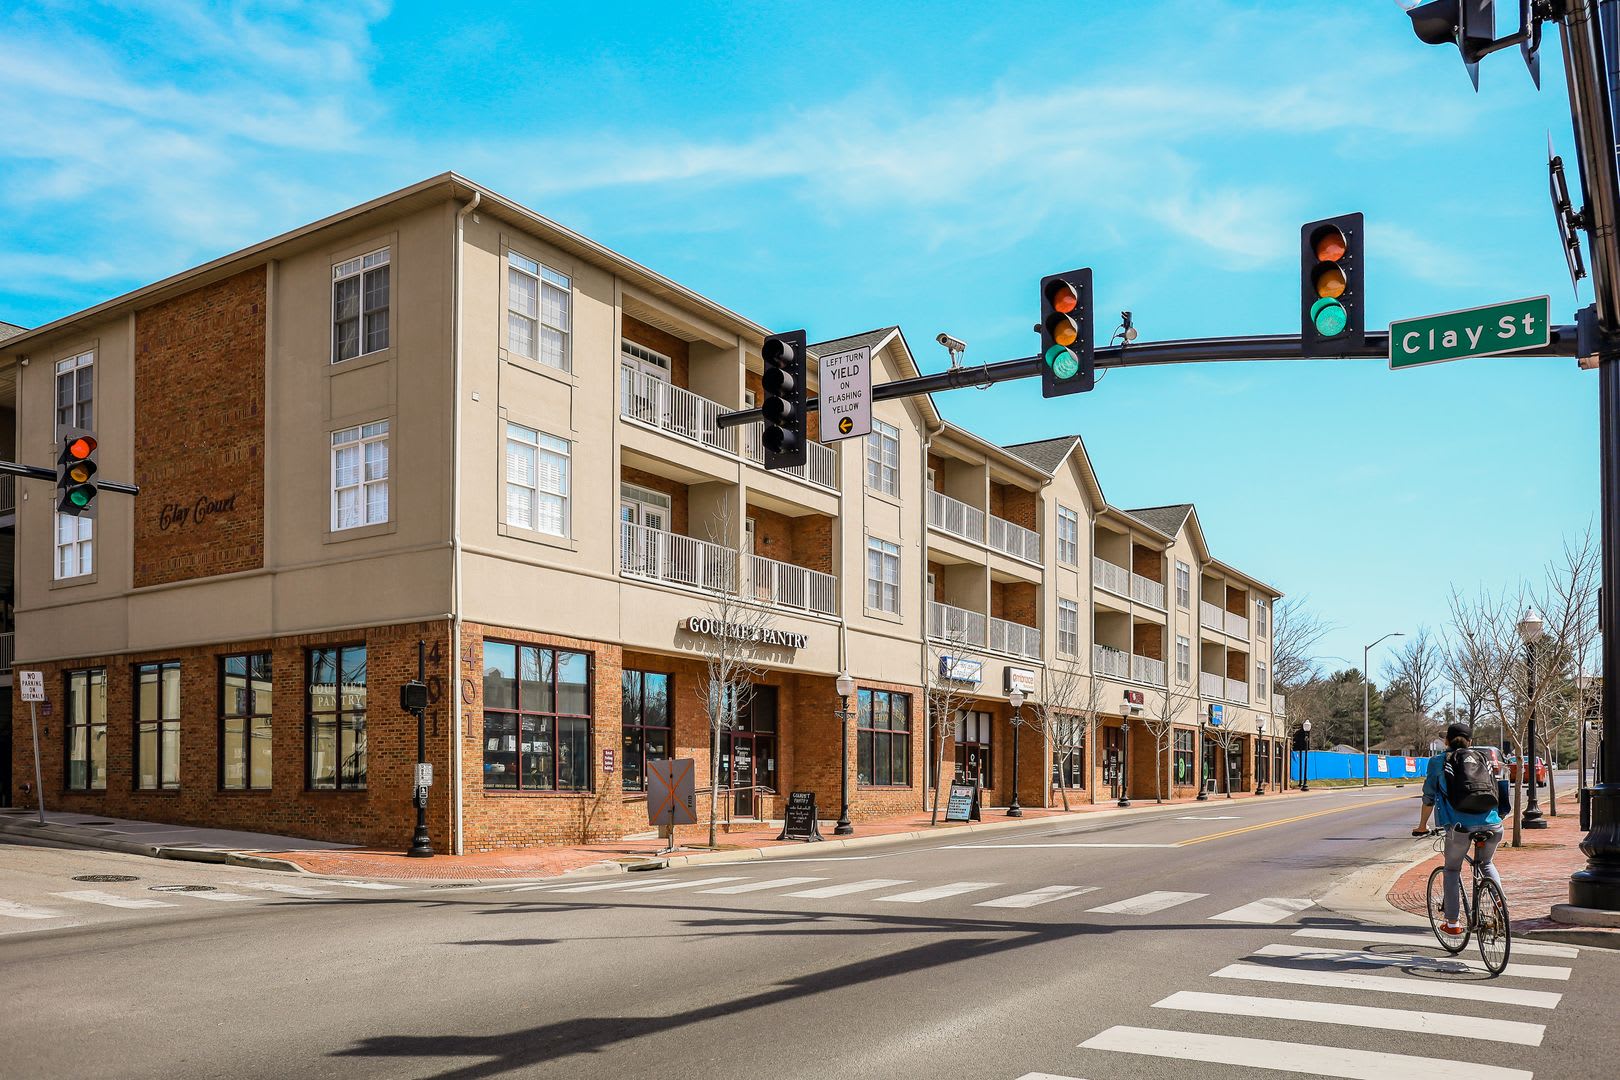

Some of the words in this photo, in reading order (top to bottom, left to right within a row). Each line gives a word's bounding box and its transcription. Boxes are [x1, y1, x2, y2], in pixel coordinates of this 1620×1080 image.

[1402, 325, 1484, 354] Clay
[1497, 312, 1535, 339] St
[826, 356, 842, 367] LEFT
[846, 352, 864, 362] TURN
[831, 364, 860, 380] YIELD
[840, 381, 850, 390] ON
[828, 390, 862, 404] FLASHING
[832, 403, 859, 415] YELLOW
[160, 503, 189, 531] Clay
[194, 494, 237, 525] Court
[763, 628, 809, 649] PANTRY
[27, 672, 36, 680] NO
[309, 681, 364, 695] GOUMET
[429, 639, 442, 737] 401
[461, 641, 476, 739] 401
[318, 694, 361, 707] PANTRY
